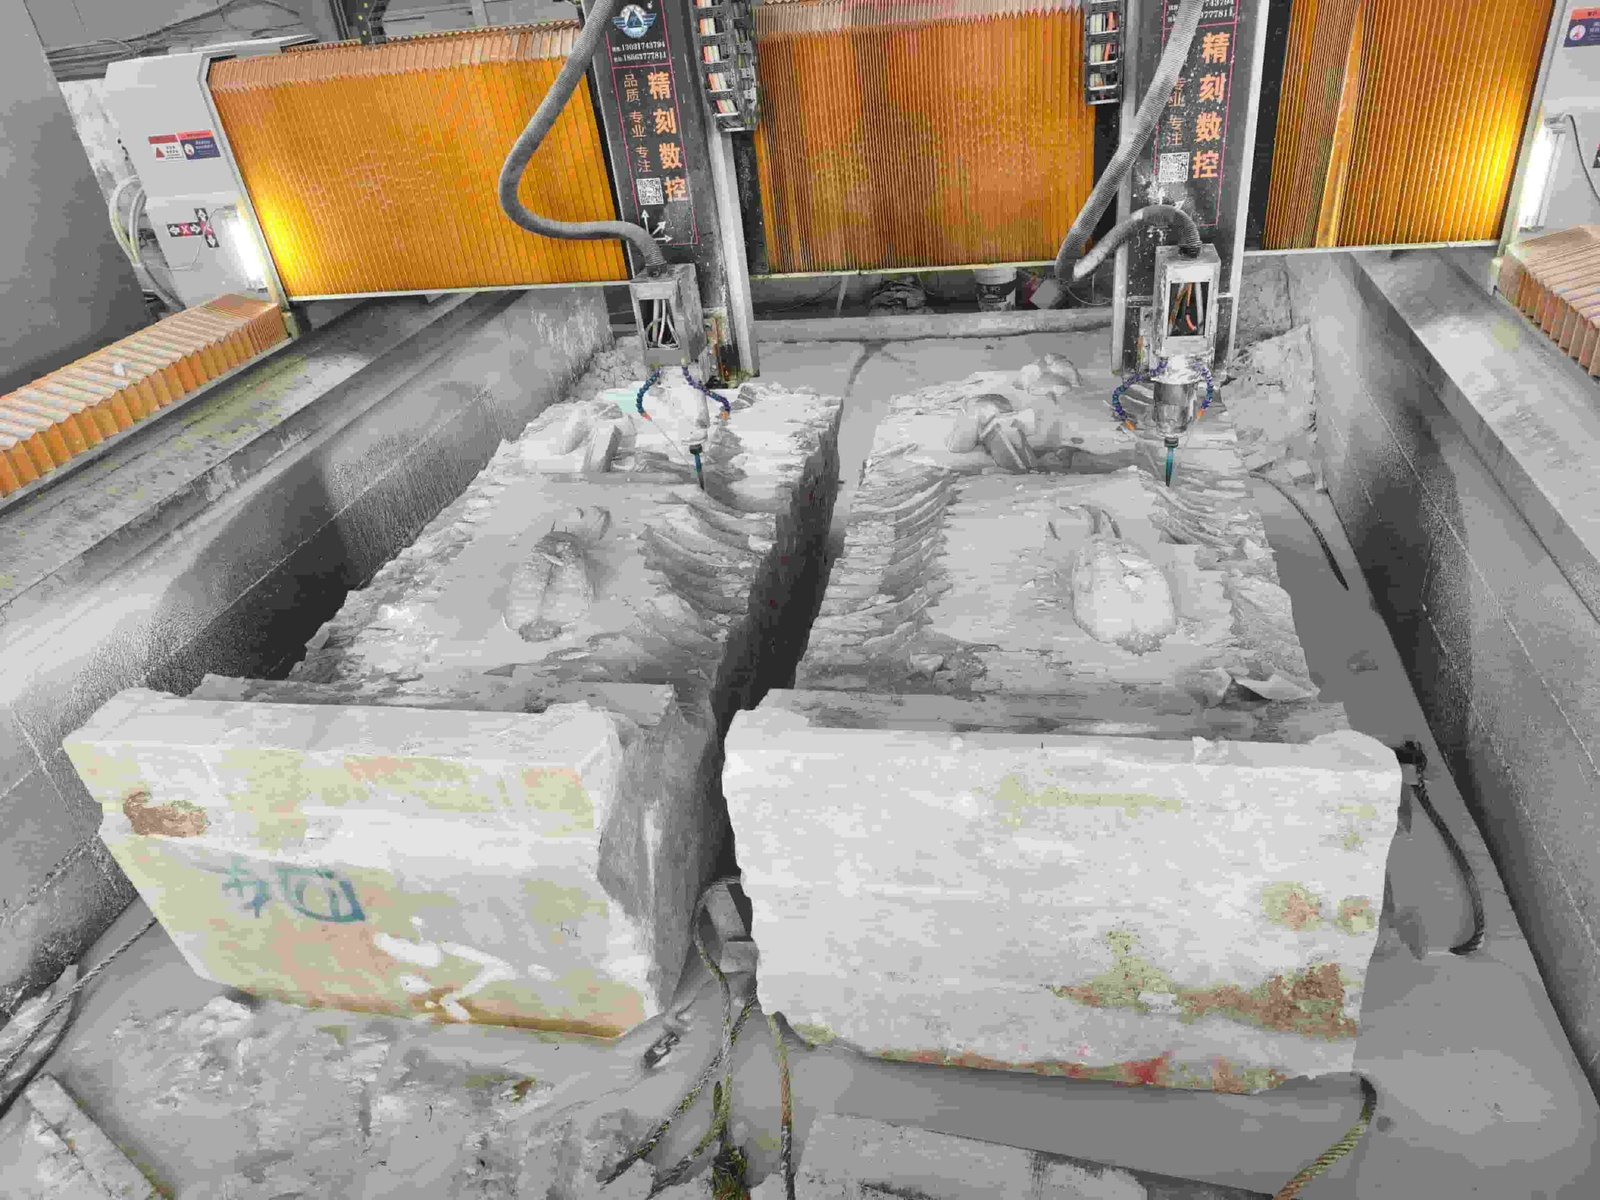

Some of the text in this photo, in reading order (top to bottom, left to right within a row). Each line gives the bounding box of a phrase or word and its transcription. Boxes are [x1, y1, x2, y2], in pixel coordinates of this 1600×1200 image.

[624, 74, 652, 173] 品质 专业 专注
[647, 71, 688, 202] 精刻数控
[1166, 114, 1184, 146] 专注
[1192, 32, 1231, 179] 精刻数控
